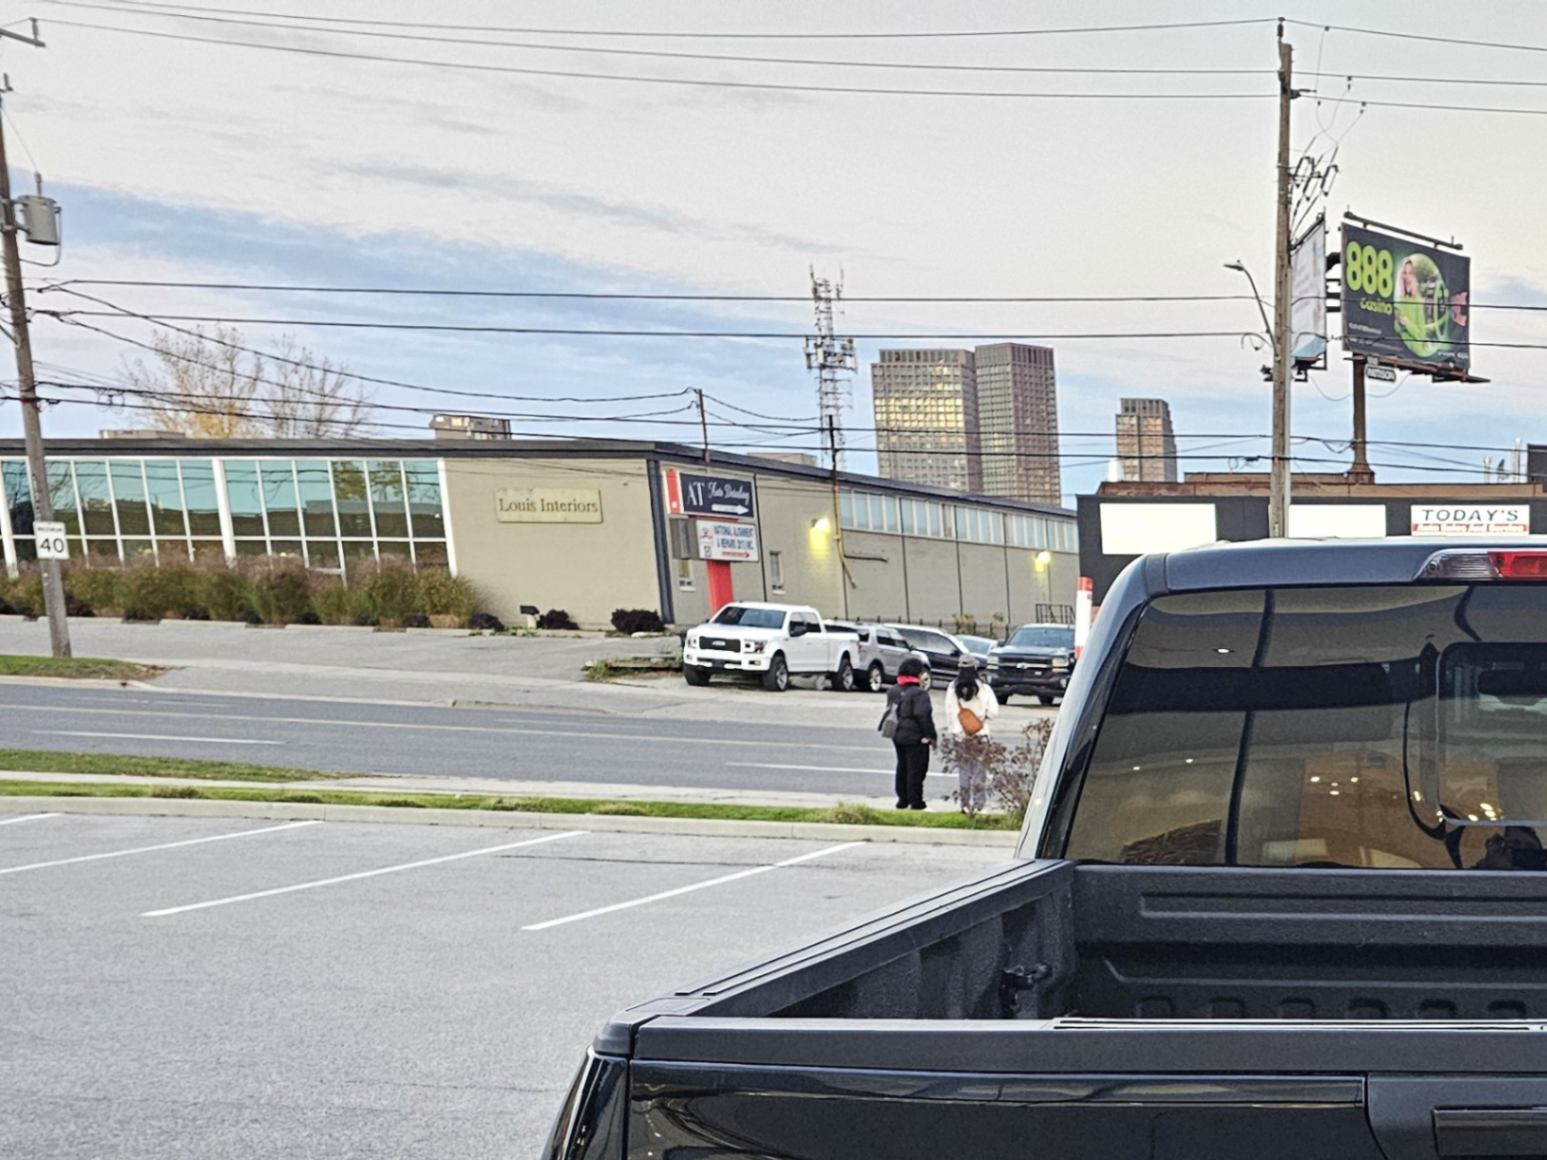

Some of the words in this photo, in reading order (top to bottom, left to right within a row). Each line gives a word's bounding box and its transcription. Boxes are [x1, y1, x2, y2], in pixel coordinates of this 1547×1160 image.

[1346, 241, 1393, 298] 888
[687, 482, 705, 506] AT
[499, 498, 536, 512] Louis
[541, 498, 599, 512] Interiors
[1421, 509, 1519, 521] TODAY'S
[40, 538, 64, 553] 40
